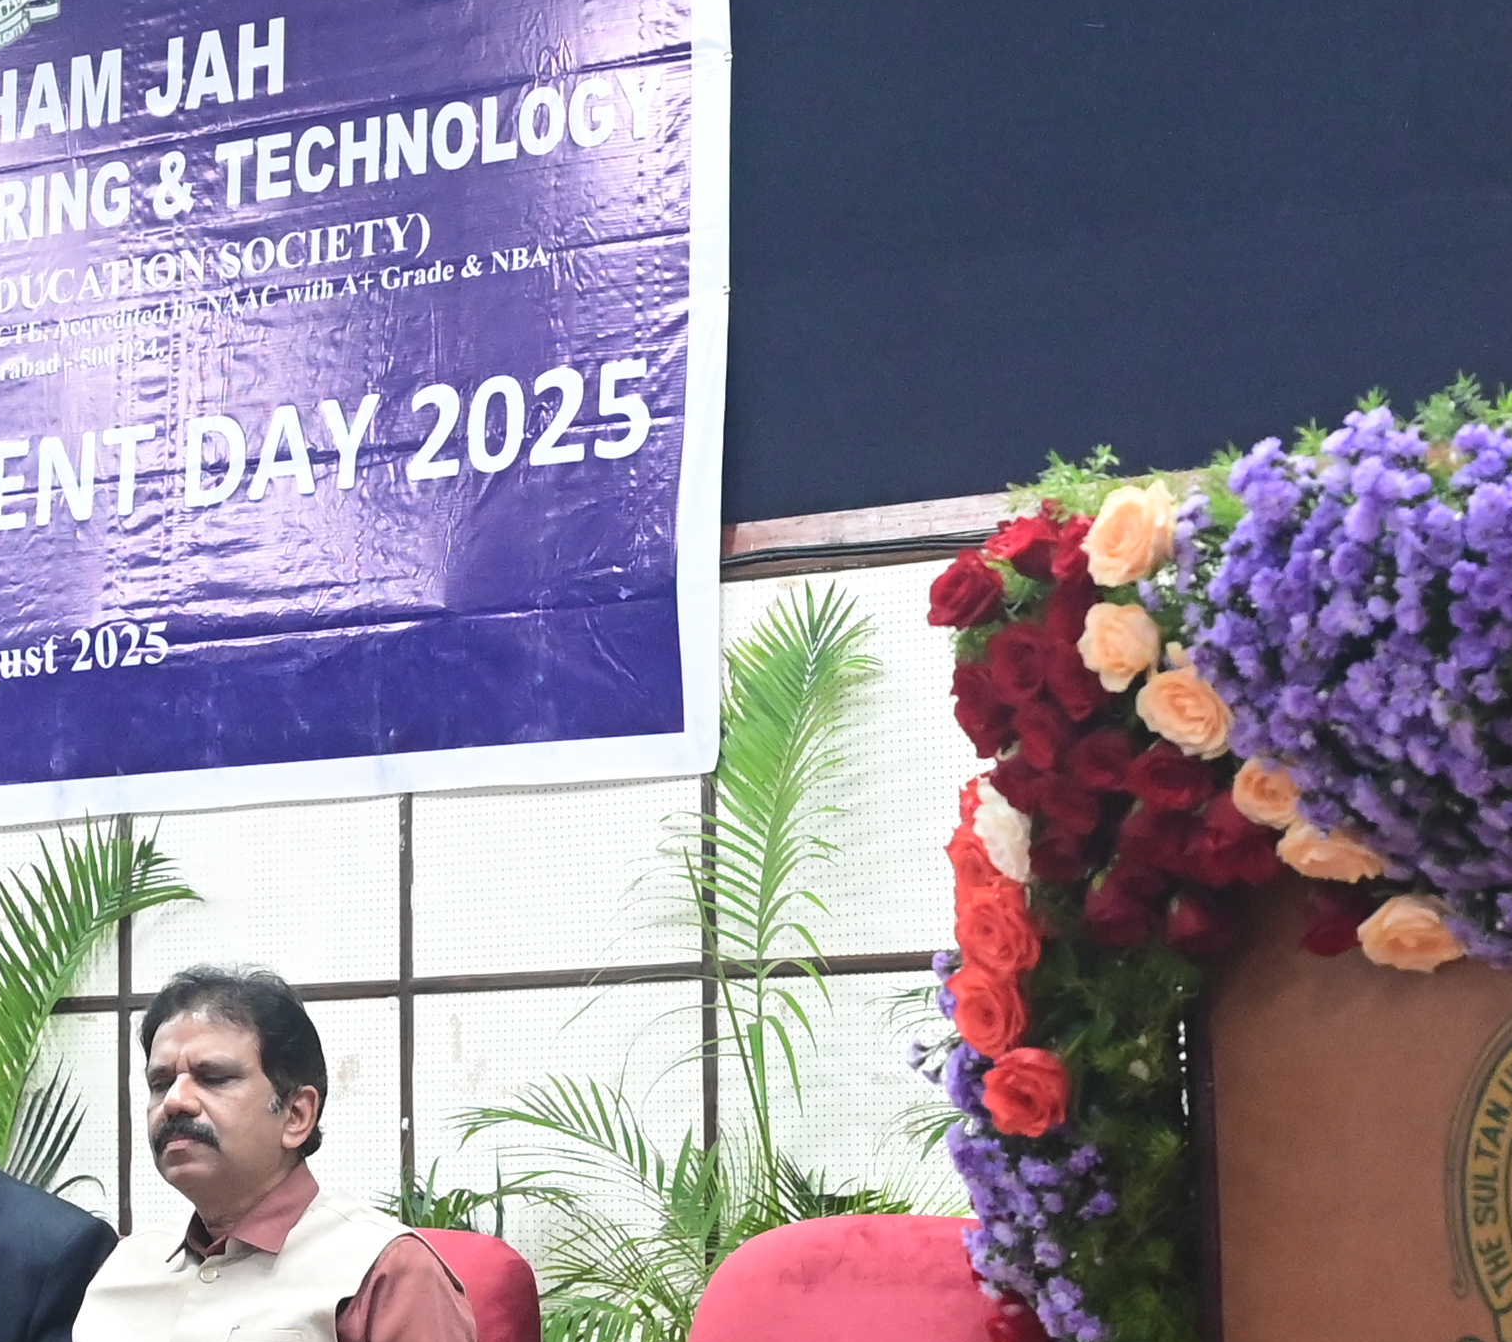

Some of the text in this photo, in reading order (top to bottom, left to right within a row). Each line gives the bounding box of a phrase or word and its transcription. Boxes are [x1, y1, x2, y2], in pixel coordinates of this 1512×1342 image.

[144, 16, 286, 118] JAH
[152, 150, 195, 217] &
[215, 75, 662, 207] TECHNOLOGY
[217, 211, 432, 279] SOCIETY)
[52, 299, 168, 340] Accredited
[172, 297, 195, 324] by
[206, 284, 279, 317] NAAC
[286, 277, 334, 305] with
[341, 270, 375, 297] A+
[380, 259, 455, 291] Grade
[460, 253, 484, 279] &
[79, 344, 116, 370] 500
[183, 393, 382, 508] DAY
[406, 357, 652, 483] 2025
[70, 621, 170, 673] 2025
